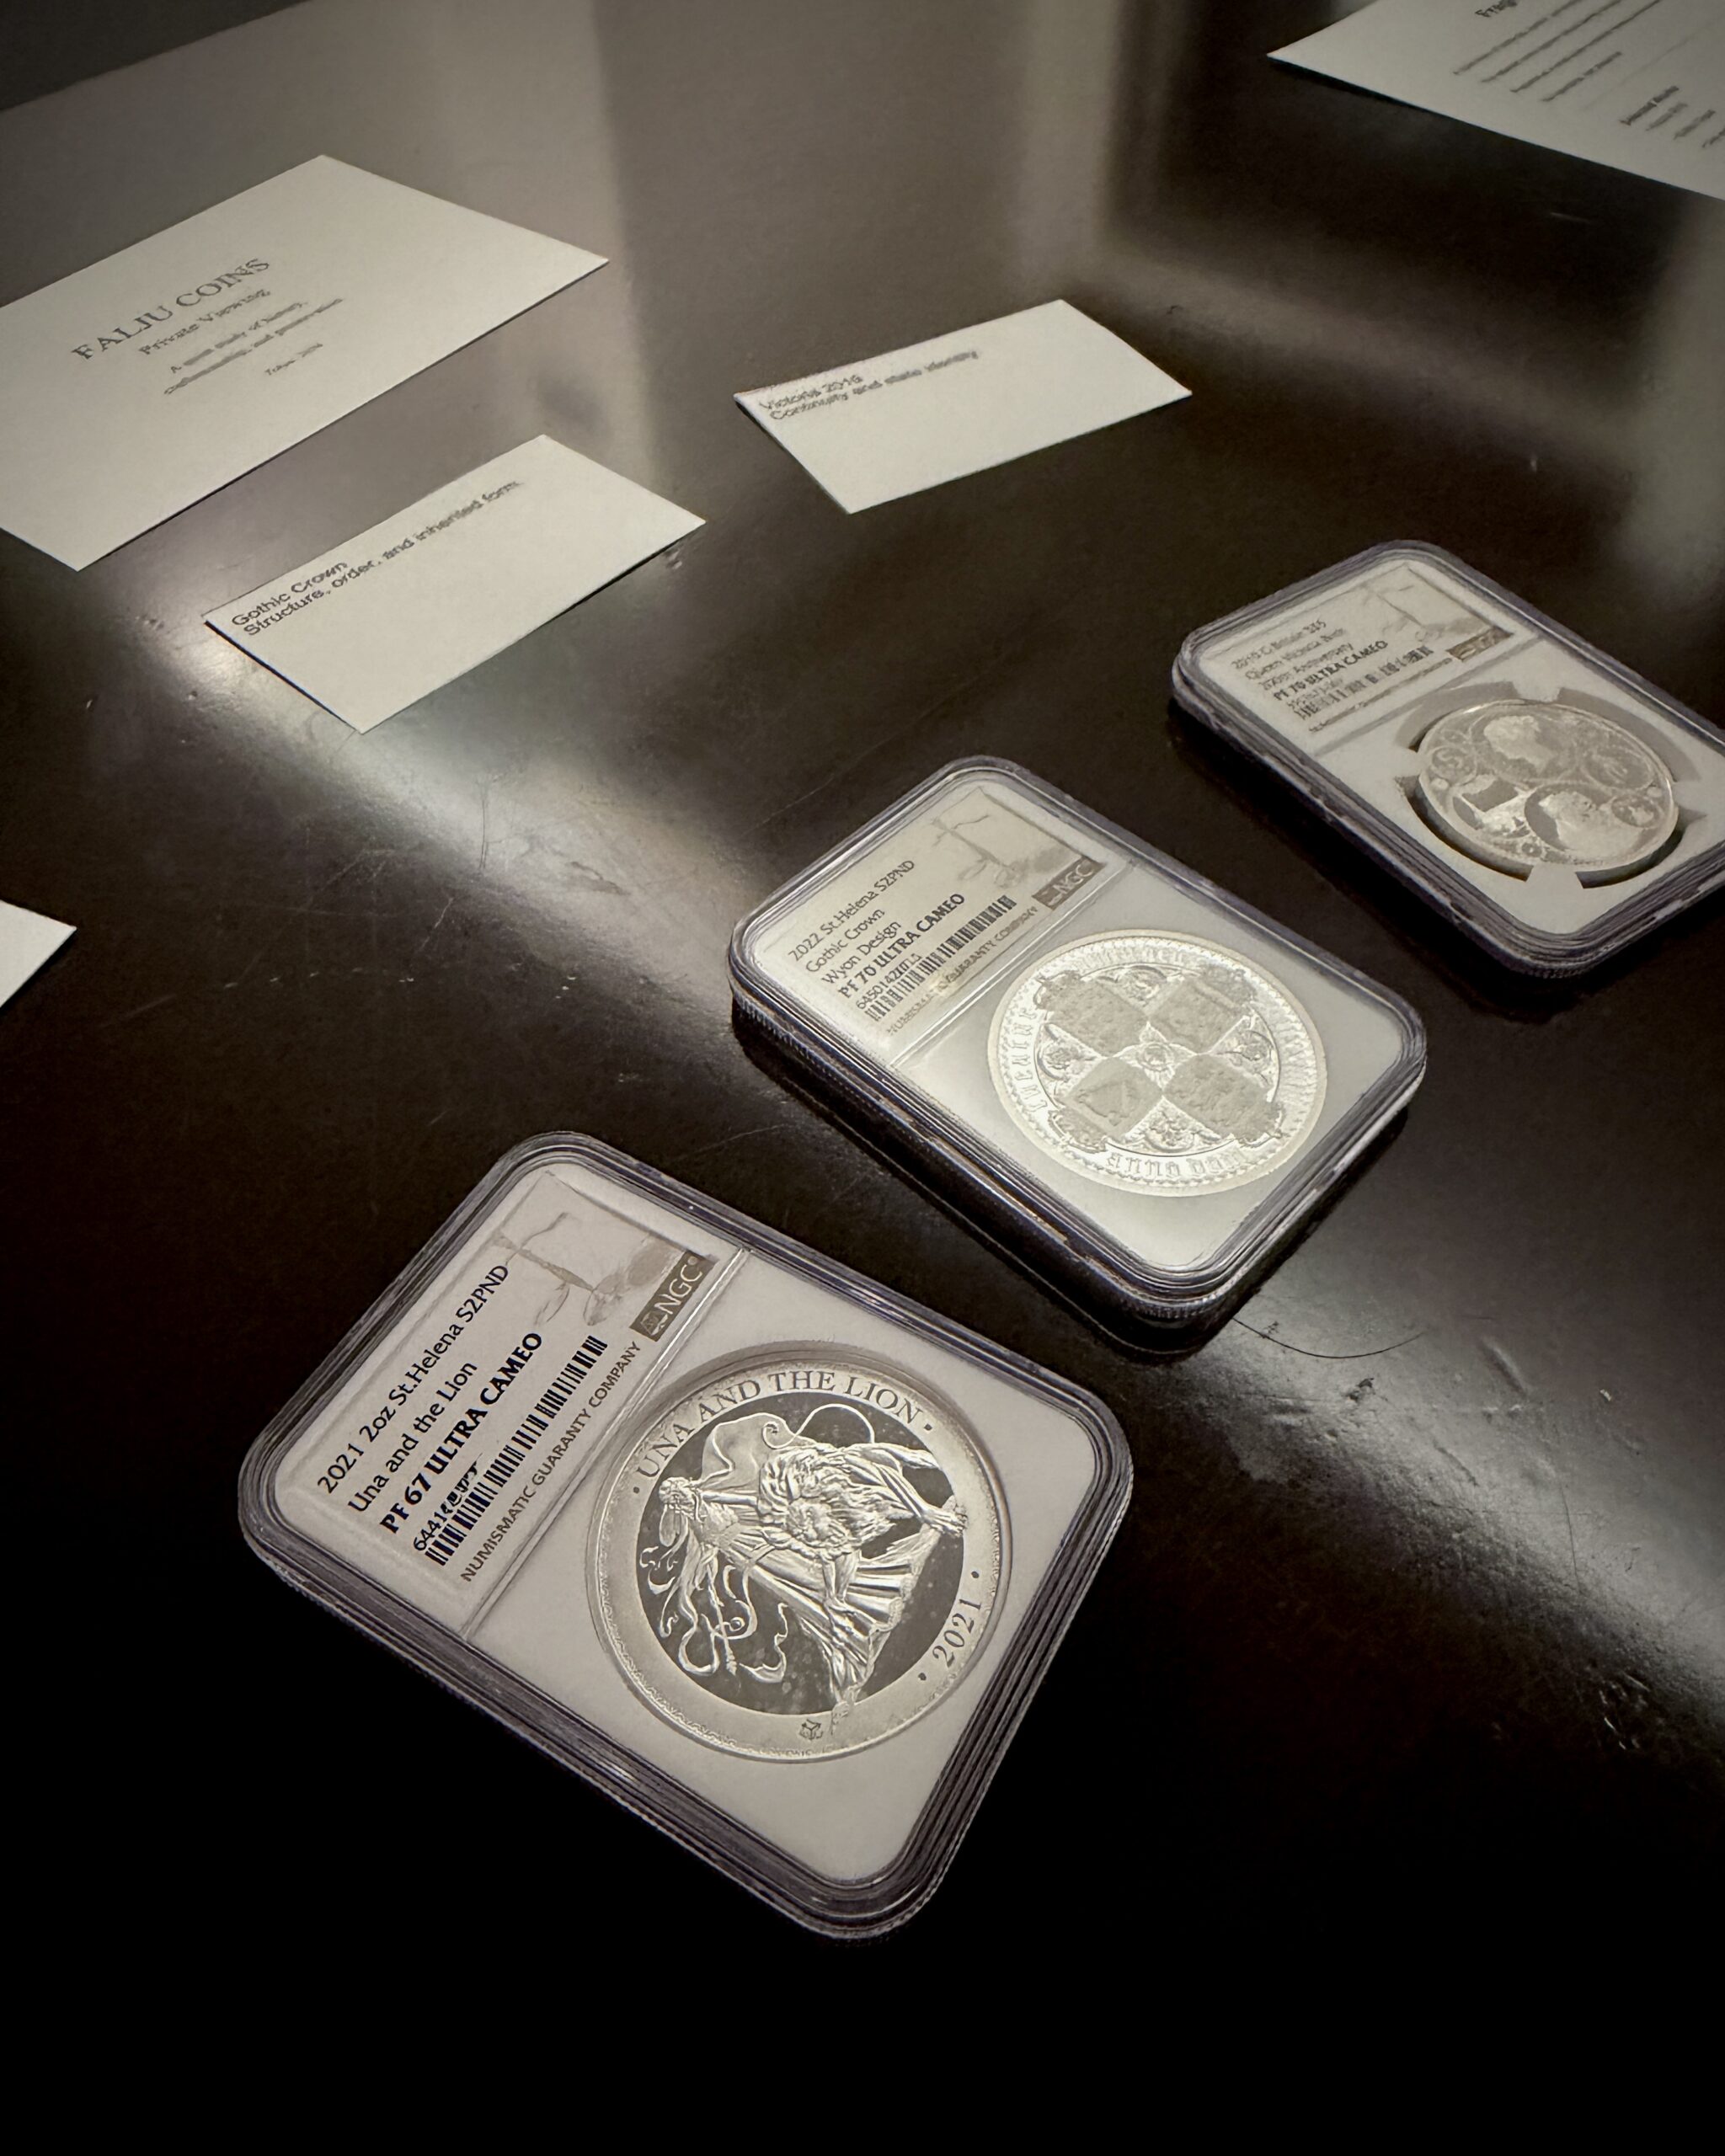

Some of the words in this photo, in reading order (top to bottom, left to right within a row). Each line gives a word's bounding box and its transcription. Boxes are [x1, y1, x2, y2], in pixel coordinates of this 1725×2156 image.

[176, 259, 270, 307] COINS
[232, 593, 291, 627] Gothic
[291, 562, 349, 594] Crown
[243, 589, 331, 636] Structure,
[1343, 640, 1389, 665] CAMEO
[788, 927, 825, 962] 2022
[820, 890, 879, 937] St.Helena
[873, 860, 916, 892] S2PND
[806, 941, 848, 974] Gothic
[845, 909, 886, 942] Crown
[822, 955, 862, 986] Wyon
[860, 920, 903, 956] Design
[837, 979, 859, 1000] PF
[854, 964, 877, 984] 70
[873, 931, 921, 968] ULTRA
[916, 894, 965, 932] CAMEO
[317, 1443, 366, 1494] 2021
[359, 1404, 397, 1443] 2oz
[389, 1324, 464, 1409] St.Helena
[457, 1265, 510, 1324] S2PND
[347, 1476, 389, 1513] Una
[385, 1434, 419, 1473] and
[414, 1401, 446, 1435] the
[442, 1361, 478, 1402] Lion
[379, 1503, 409, 1534] PF
[404, 1473, 431, 1505] 67
[426, 1406, 489, 1475] ULTRA
[479, 1331, 543, 1406] CAMEO
[461, 1485, 536, 1582] NUMISMATIC
[531, 1409, 593, 1486] GUARANTY
[588, 1341, 641, 1409] COMPANY
[636, 1419, 696, 1479] UNA
[697, 1380, 761, 1423] AND
[768, 1370, 836, 1393] THE
[848, 1376, 926, 1424] LION
[931, 1598, 984, 1670] 2021
